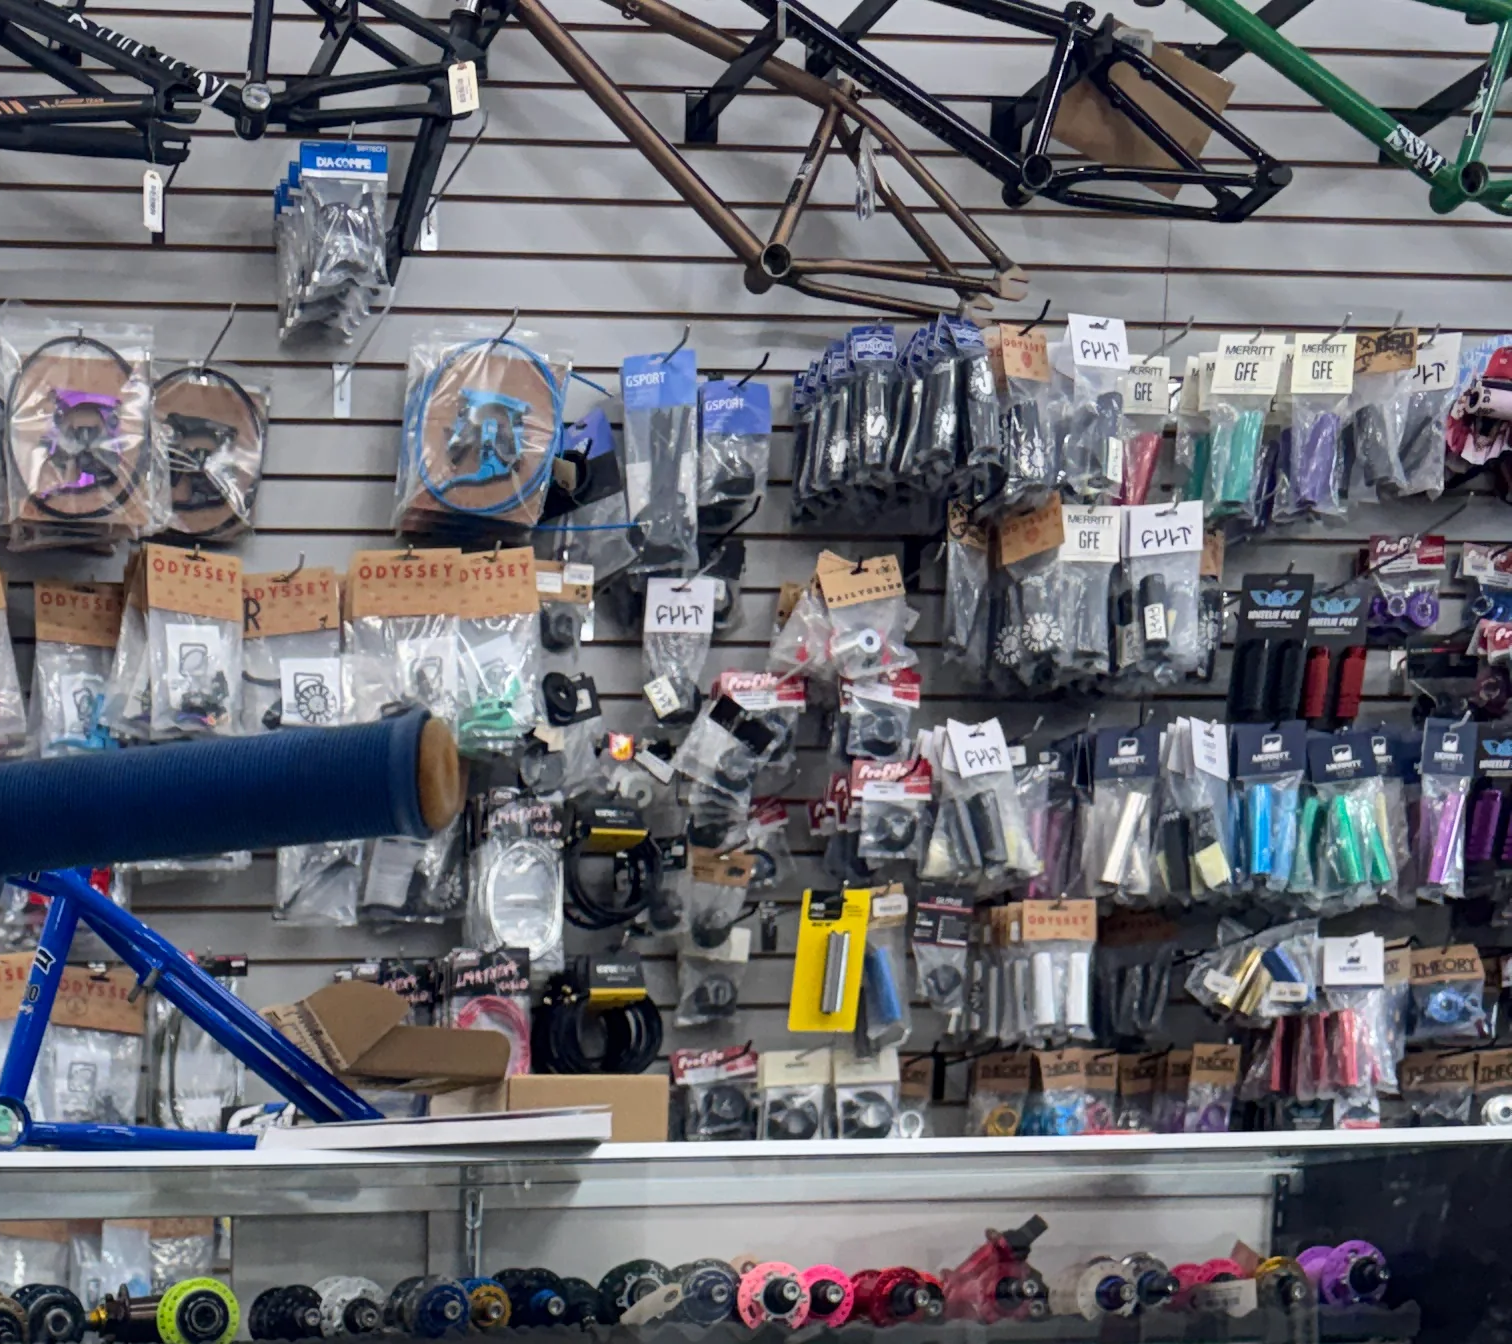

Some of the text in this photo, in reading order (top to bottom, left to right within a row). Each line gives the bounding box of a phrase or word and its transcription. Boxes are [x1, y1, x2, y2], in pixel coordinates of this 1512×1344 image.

[1384, 124, 1445, 176] S&M
[1225, 345, 1276, 356] MERRITT
[1301, 344, 1348, 355] MERRITT
[625, 371, 667, 388] GSPORT
[1234, 362, 1260, 382] GFE
[1311, 360, 1334, 380] GFE
[1134, 382, 1153, 402] GFE
[704, 397, 745, 412] GSPORT
[1067, 514, 1114, 526] MERRITT
[1078, 530, 1101, 550] GFE
[152, 557, 238, 585] ODYSSEY
[358, 562, 454, 581] ODYSSEY
[459, 562, 530, 583] DYSSEY
[1027, 914, 1088, 925] ODYSSEY
[1413, 957, 1477, 978] THEORY
[58, 978, 128, 1000] ODYSSE
[1481, 1064, 1512, 1082] THEO
